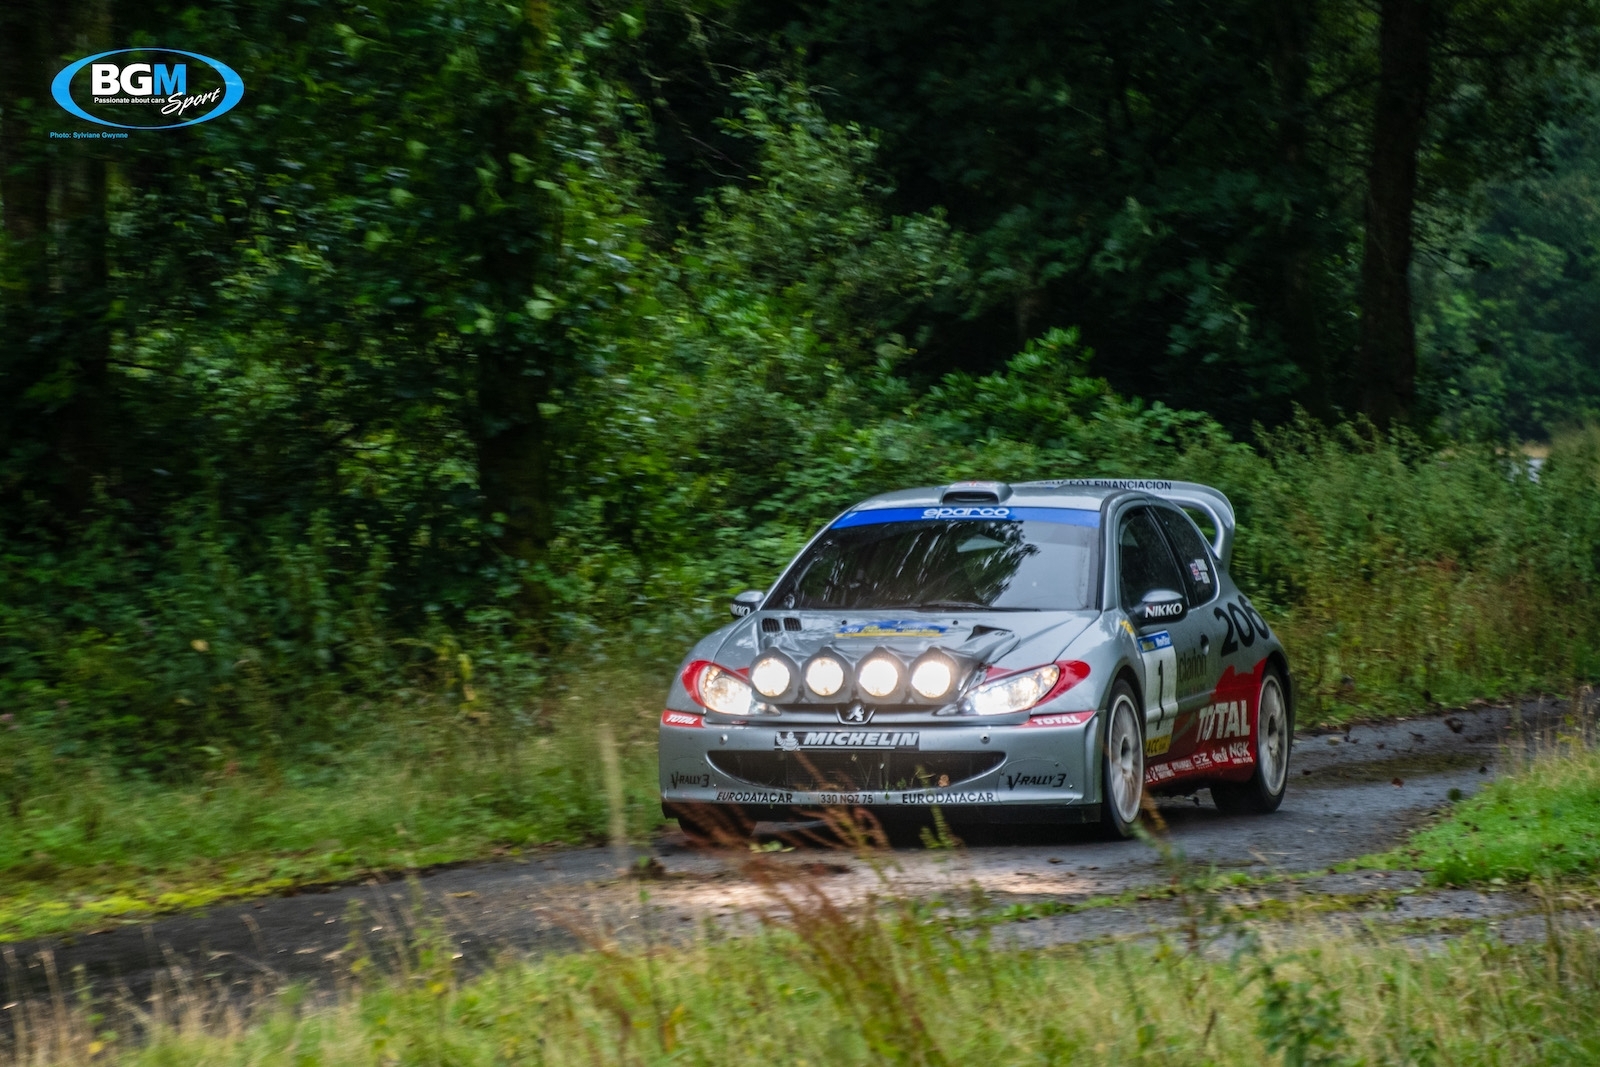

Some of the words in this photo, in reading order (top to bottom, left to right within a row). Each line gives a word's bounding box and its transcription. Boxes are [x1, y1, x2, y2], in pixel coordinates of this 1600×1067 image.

[921, 507, 1011, 520] sparco
[1144, 603, 1183, 618] NIKKO
[1213, 594, 1270, 658] 206
[1178, 648, 1208, 682] clarion
[1157, 659, 1165, 731] 1
[666, 714, 699, 725] TOTAL
[1032, 715, 1082, 725] TOTAL
[1196, 700, 1251, 743] TOTAL
[803, 732, 920, 747] MICHELIN
[1006, 772, 1055, 791] V-RALLY
[716, 791, 793, 804] EURODATACAR
[820, 794, 838, 804] 330
[862, 794, 874, 804] 75
[902, 791, 995, 804] EURODATACAR
